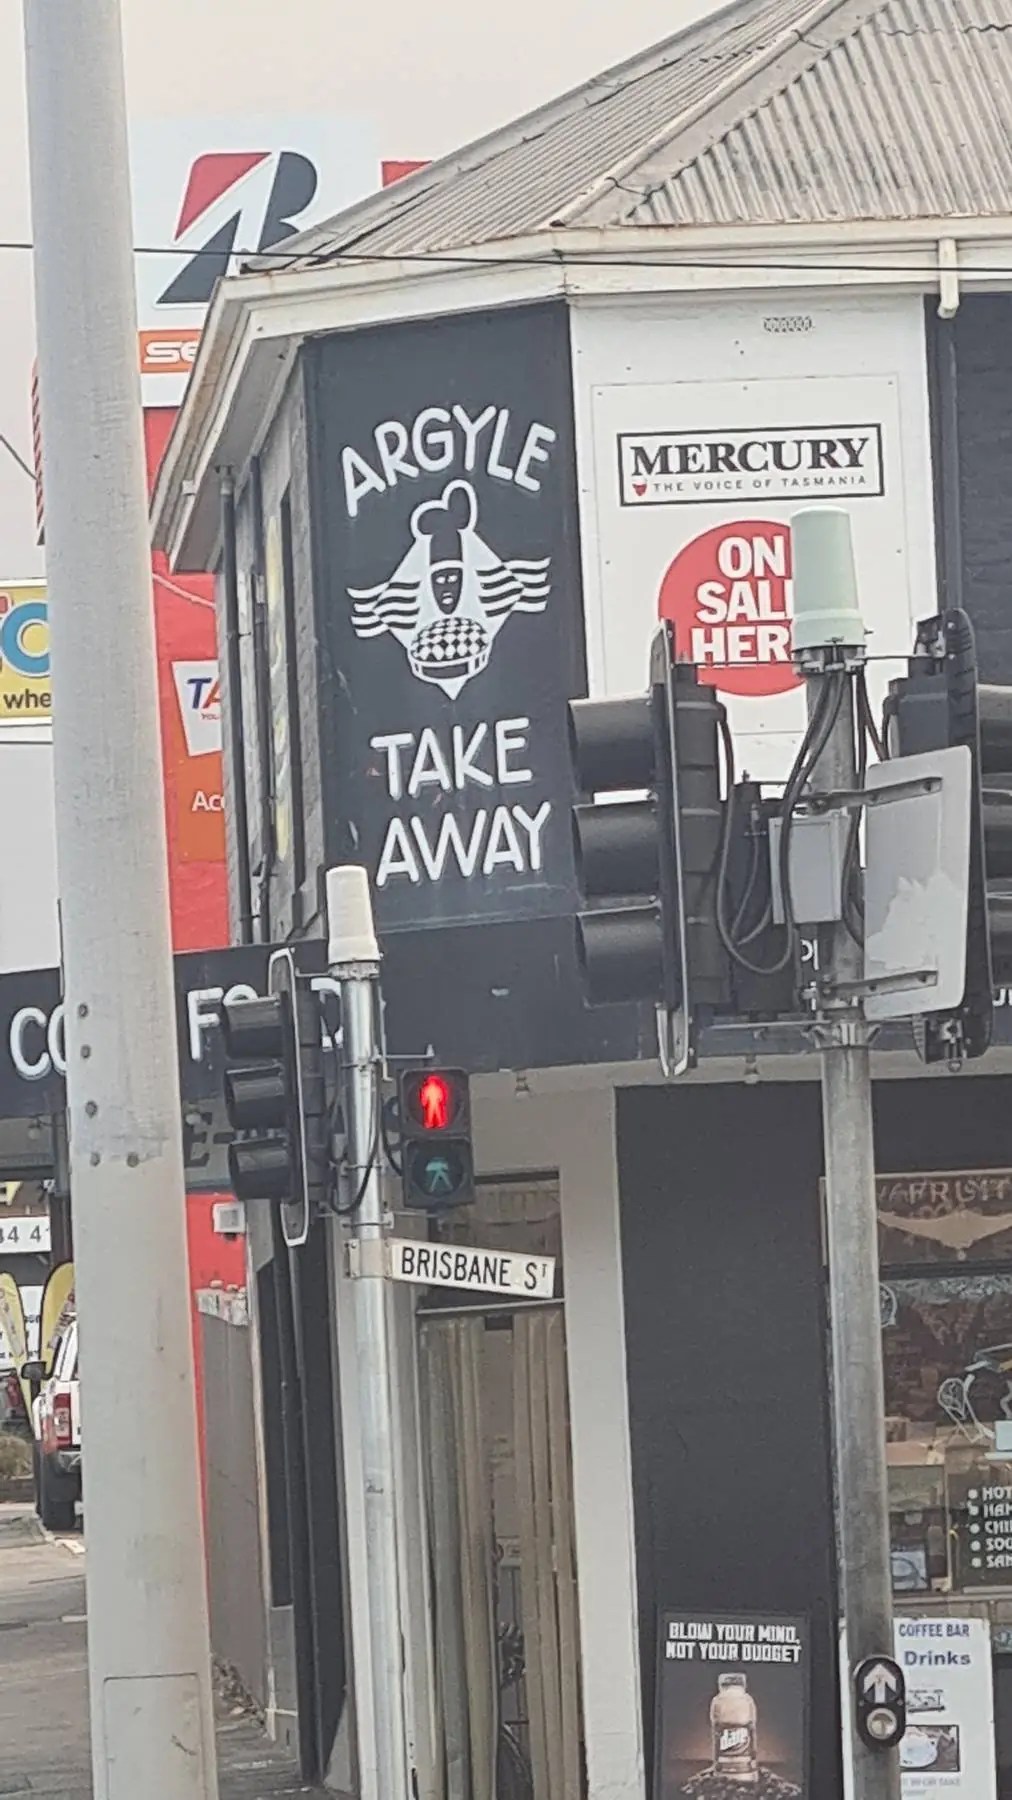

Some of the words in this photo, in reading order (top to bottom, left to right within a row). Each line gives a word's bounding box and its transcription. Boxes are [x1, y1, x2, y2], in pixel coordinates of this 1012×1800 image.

[342, 405, 557, 517] ARGYLE
[630, 437, 870, 477] MERCURY
[654, 482, 684, 493] THE
[694, 480, 743, 491] VOICE
[752, 479, 772, 489] OF
[782, 475, 867, 488] TASMANIA
[718, 535, 786, 580] ON
[691, 624, 794, 663] HER
[370, 717, 533, 800] TAKE
[375, 801, 551, 887] AWAY
[401, 1246, 512, 1287] BRISBANE
[669, 1622, 713, 1640] BLOW
[715, 1624, 754, 1641] YOUR
[899, 1624, 942, 1638] COFFEE
[946, 1624, 970, 1637] BAR
[665, 1641, 696, 1659] NOT
[699, 1642, 739, 1660] YOUR
[742, 1644, 801, 1663] BUDGET
[904, 1651, 971, 1666] Drinks
